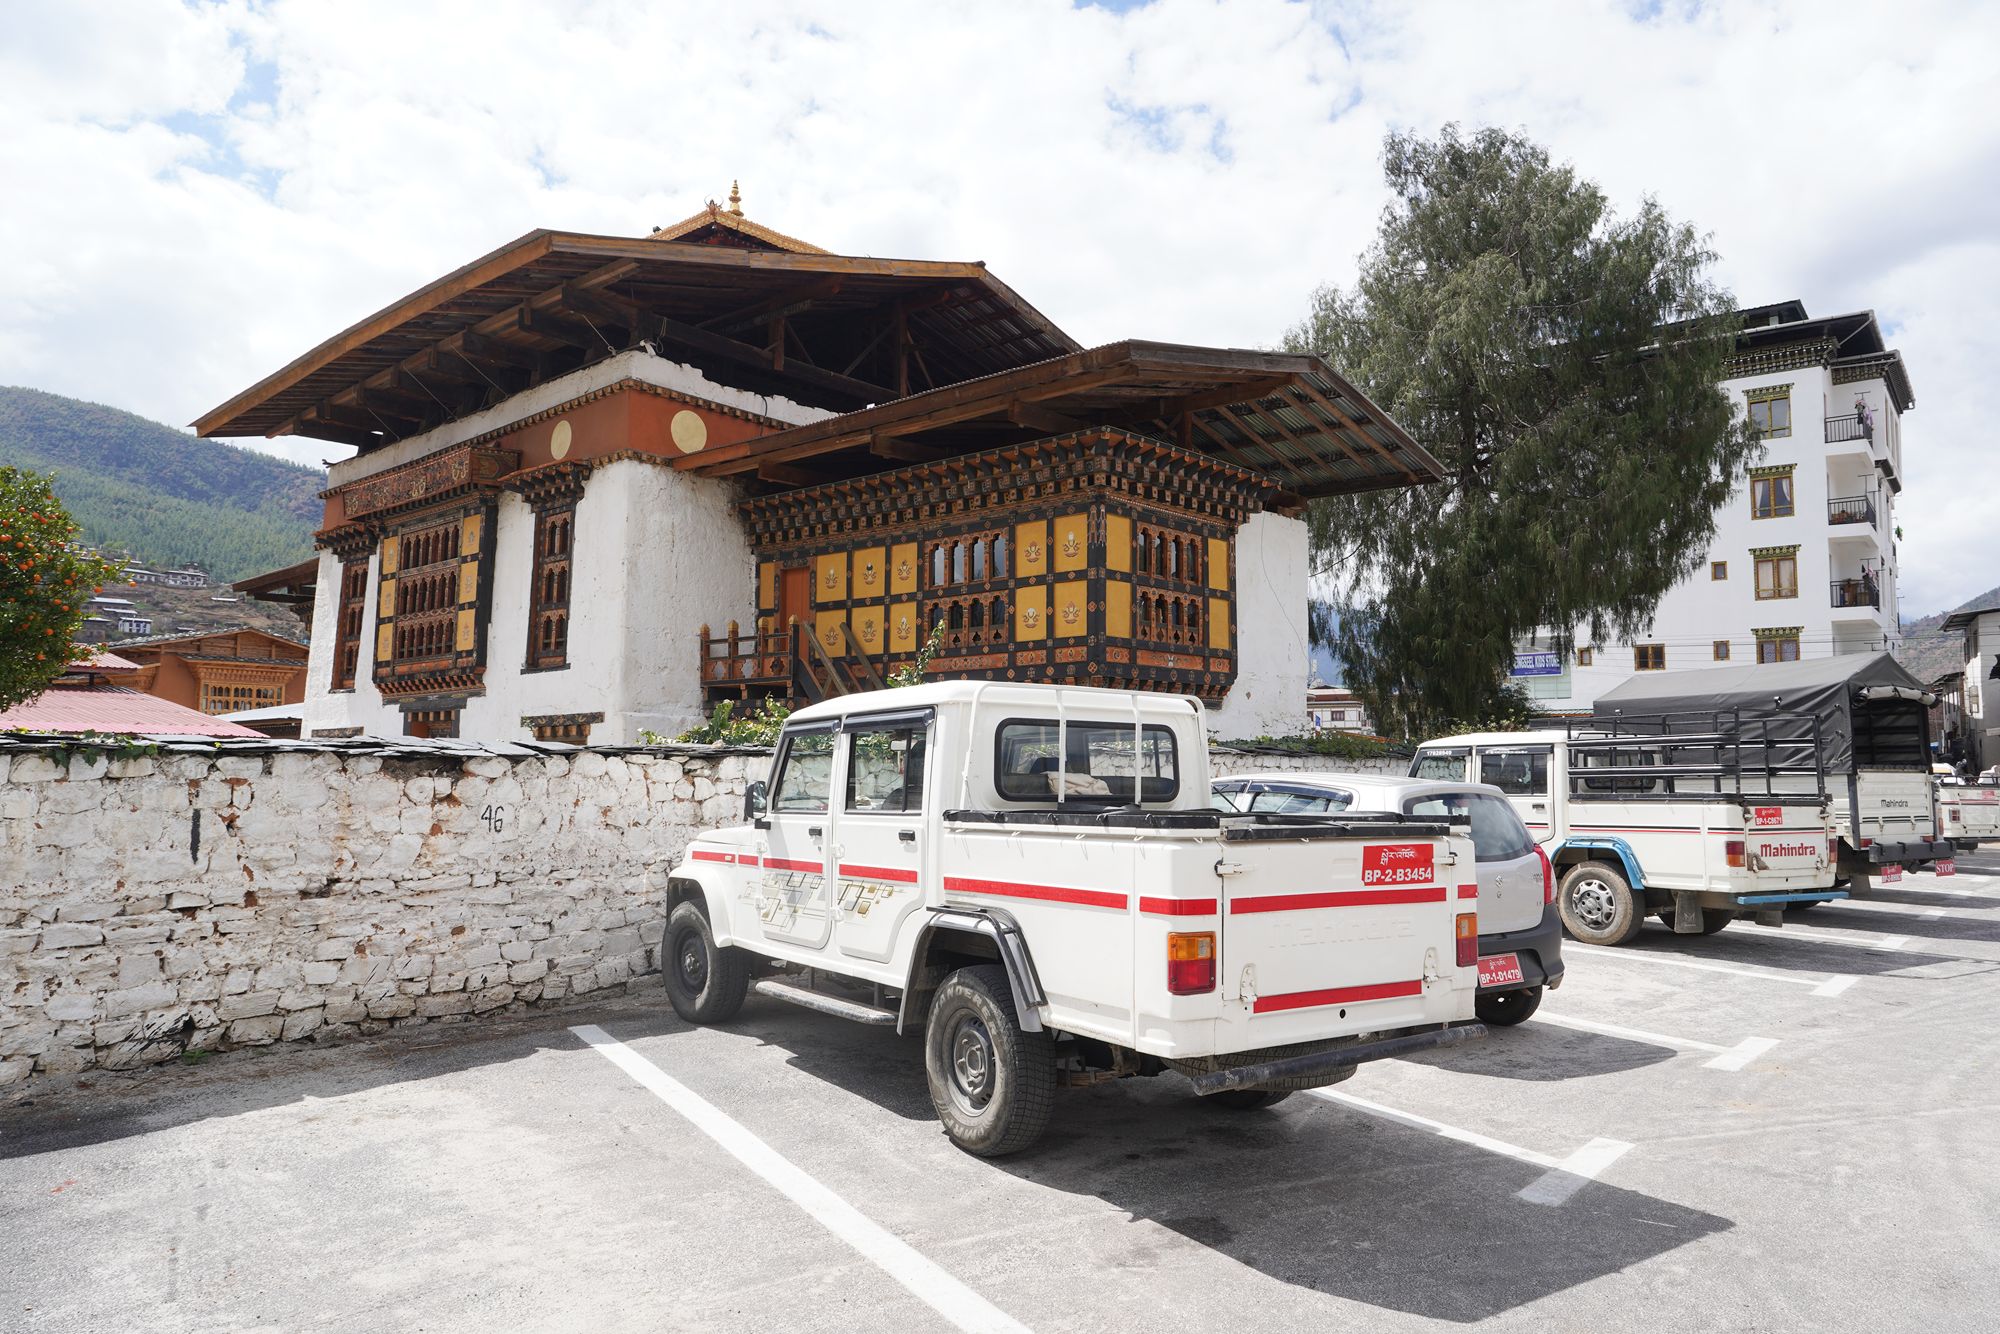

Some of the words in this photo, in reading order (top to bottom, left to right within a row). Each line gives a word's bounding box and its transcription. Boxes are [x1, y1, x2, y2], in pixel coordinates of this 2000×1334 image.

[1881, 799, 1908, 807] Mahindra
[481, 804, 504, 833] 46
[1760, 842, 1816, 857] Mahindra
[1364, 867, 1432, 883] BP-2-B3454
[1936, 864, 1954, 873] STOP
[1480, 969, 1521, 984] BP-1-D1479
